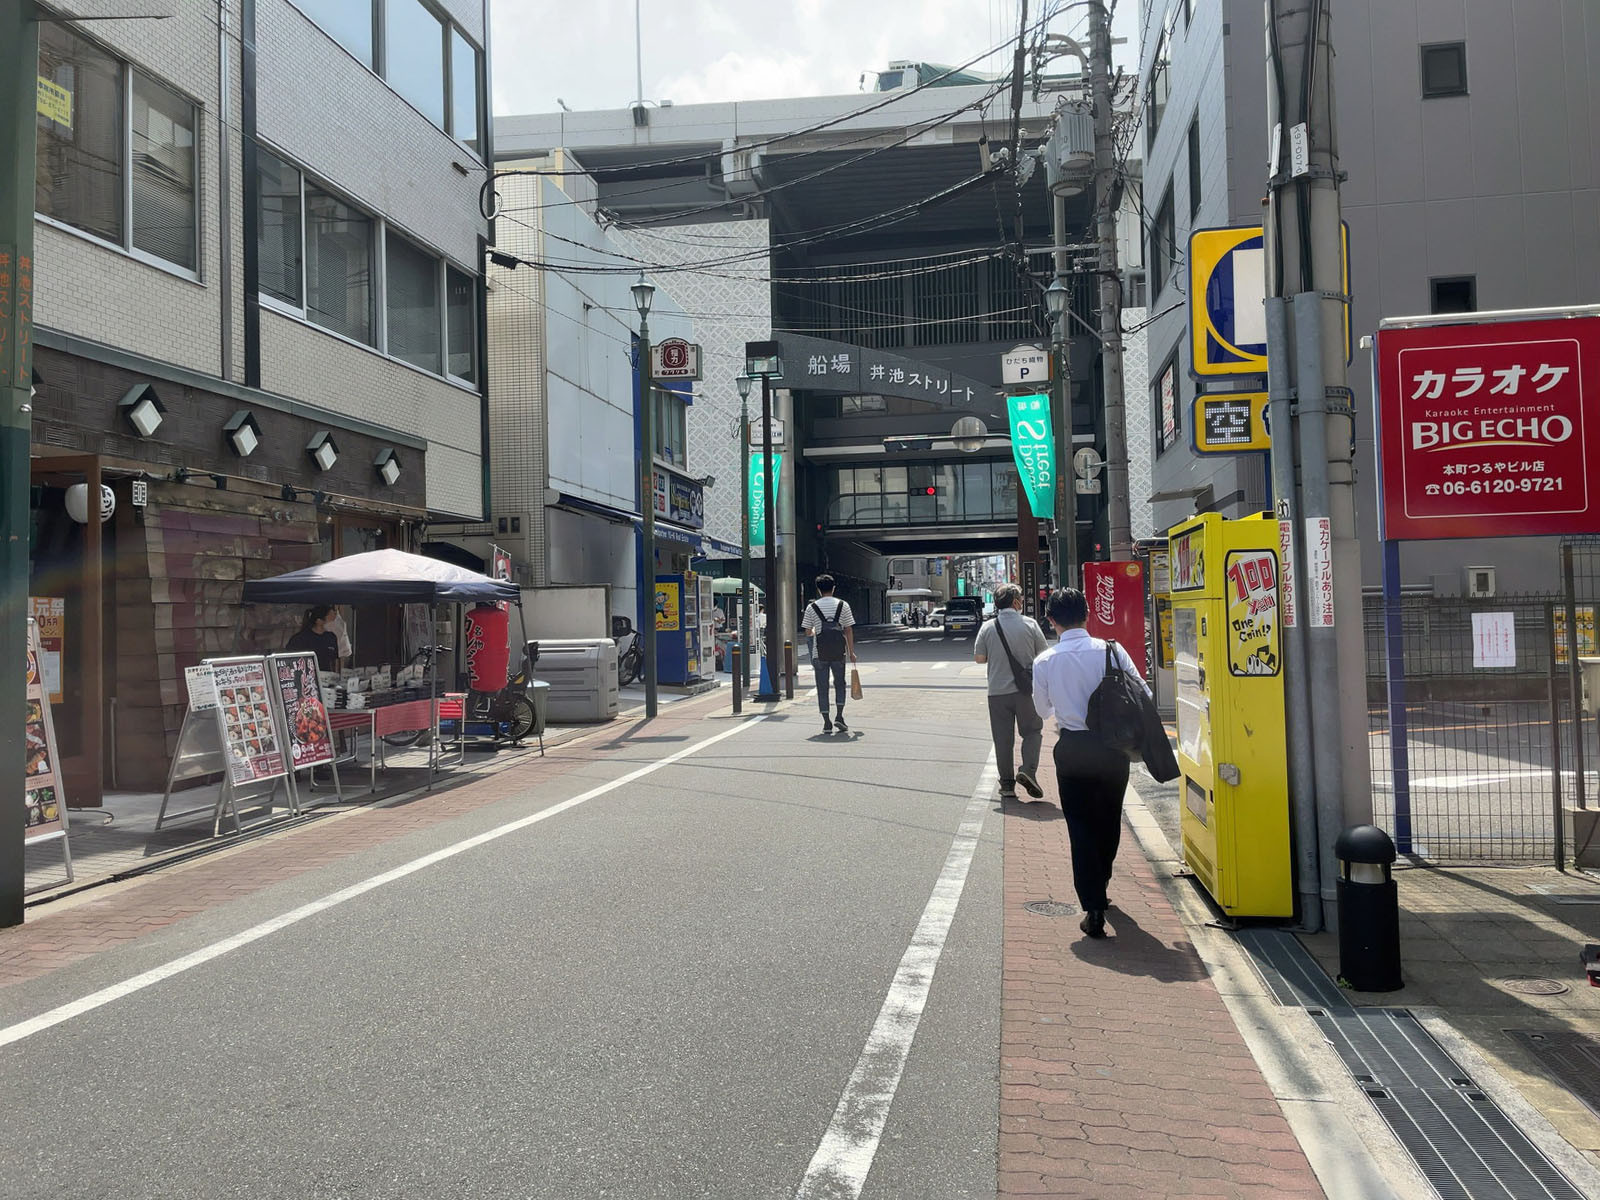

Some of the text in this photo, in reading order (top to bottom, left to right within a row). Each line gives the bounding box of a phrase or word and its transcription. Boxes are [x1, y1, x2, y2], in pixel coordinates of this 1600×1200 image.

[807, 354, 975, 402] 船場 丼池ストリート
[1020, 367, 1030, 380] P
[1411, 364, 1569, 400] カラオケ
[1206, 402, 1249, 443] 空
[1425, 404, 1555, 417] Karaoke Entertainment
[1412, 415, 1573, 450] BIG ECHO
[1442, 460, 1545, 476] 本町つるやビル店
[1443, 477, 1563, 495] 06-6120-9721
[1227, 557, 1275, 602] 100
[1280, 522, 1294, 625] 電力ケーブルあり注意
[1319, 519, 1333, 625] 電力ケーブルあり注意
[1097, 574, 1115, 625] Coca-Cola
